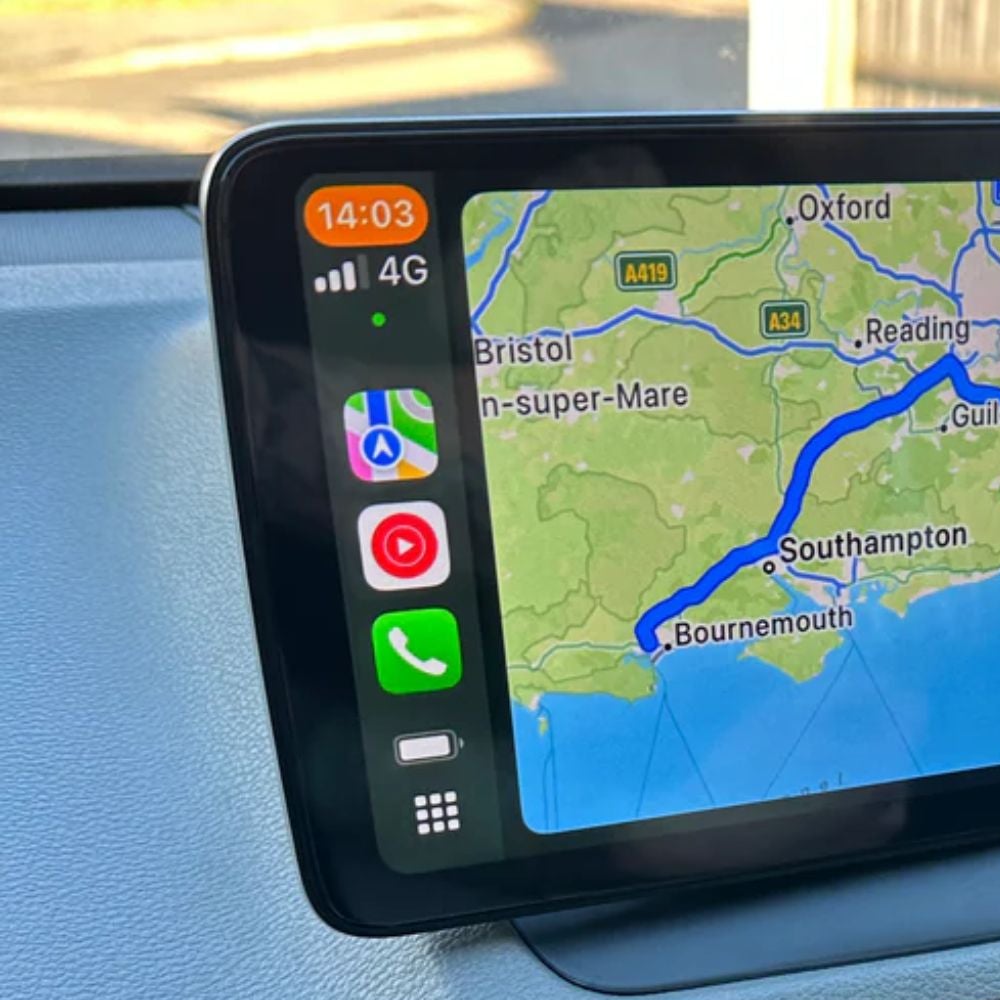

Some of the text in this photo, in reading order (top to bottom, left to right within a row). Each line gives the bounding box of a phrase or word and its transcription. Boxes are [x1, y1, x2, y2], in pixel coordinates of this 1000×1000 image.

[317, 199, 416, 231] 14:03
[799, 193, 891, 221] Oxford
[378, 254, 428, 287] 4G
[624, 261, 669, 284] A419
[768, 311, 802, 332] A34
[866, 317, 970, 345] Reading
[474, 334, 573, 365] Bristol
[481, 382, 689, 419] n-super-Mare
[778, 524, 968, 566] Southampton
[674, 606, 853, 647] Bournemouth
